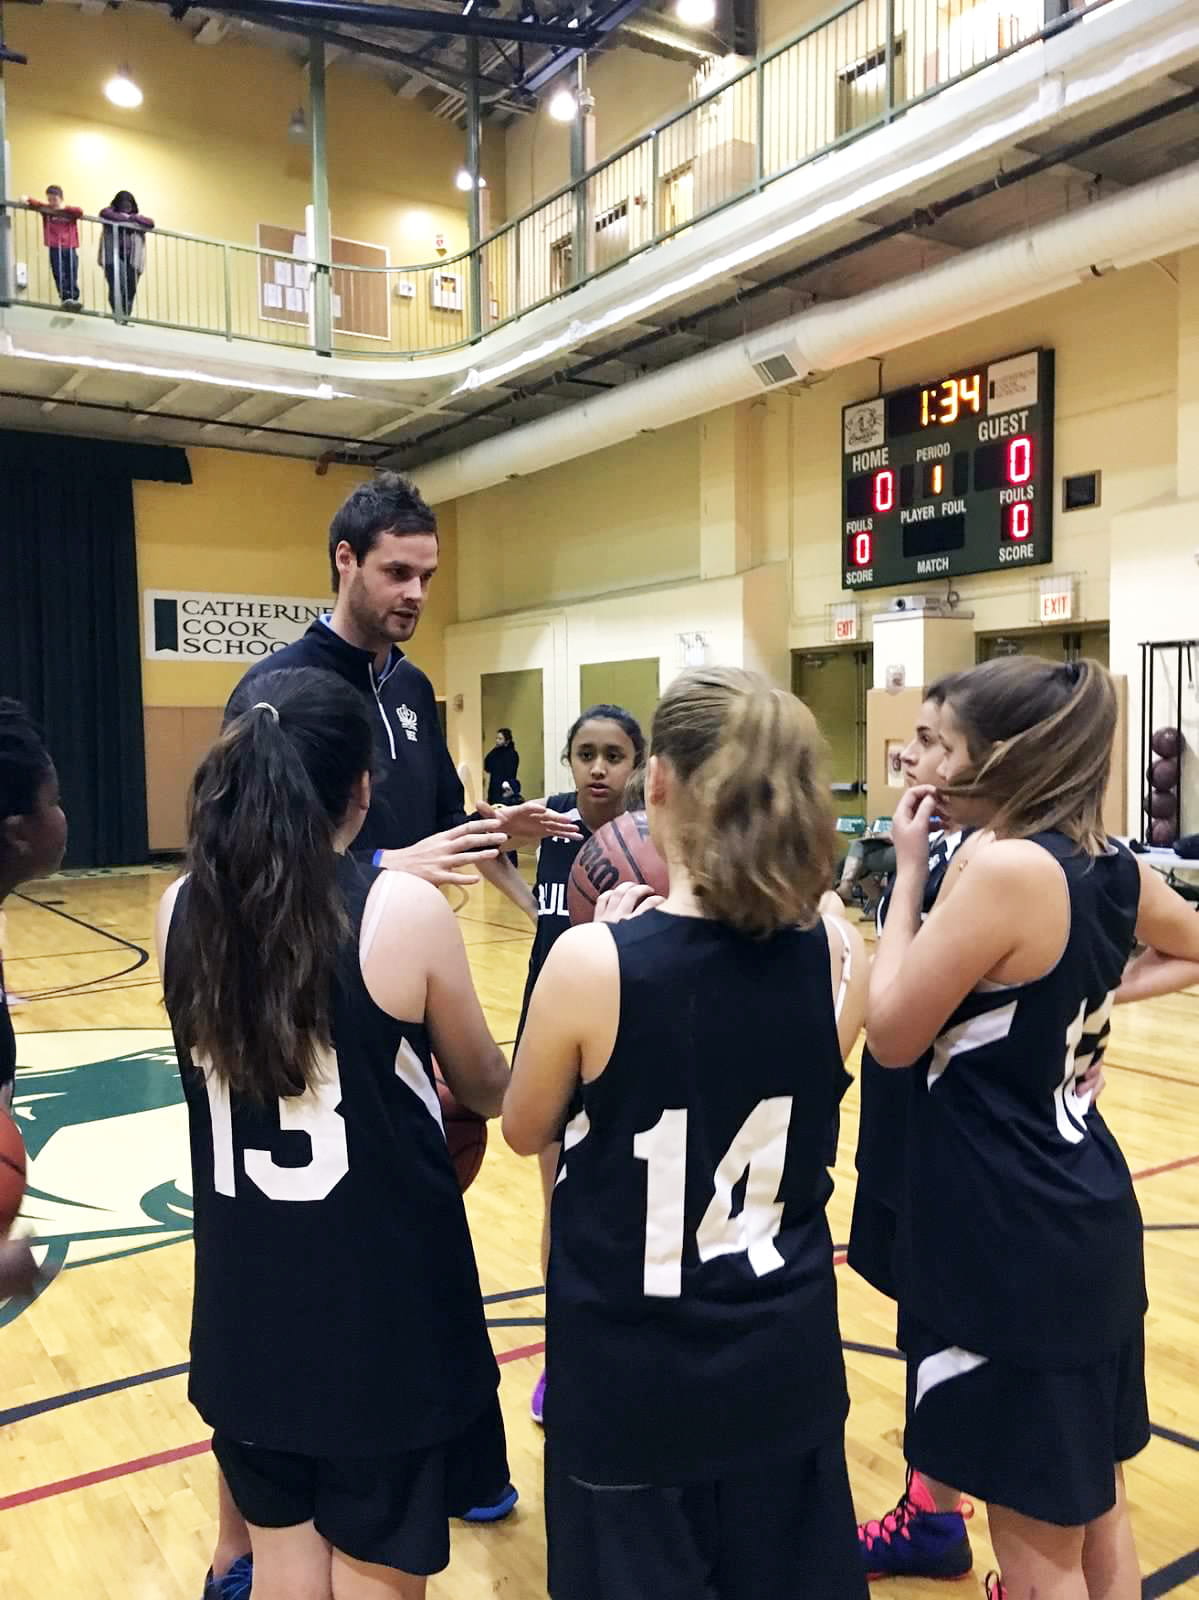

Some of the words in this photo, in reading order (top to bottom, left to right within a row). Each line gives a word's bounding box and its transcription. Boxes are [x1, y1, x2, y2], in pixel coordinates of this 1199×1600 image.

[922, 374, 980, 426] 1:34
[978, 411, 1029, 441] GUEST
[852, 447, 889, 472] HOME
[916, 442, 951, 462] PERIOD
[1010, 438, 1031, 483] 0
[876, 471, 893, 511] 0
[932, 464, 942, 494] 1
[1000, 485, 1034, 504] FOULS
[900, 505, 935, 524] PLAYER
[942, 500, 967, 515] FOUL
[1012, 503, 1029, 537] 0
[846, 518, 873, 534] FOULS
[856, 533, 870, 564] 0
[998, 543, 1034, 562] SCORE
[846, 569, 873, 585] SCORE
[917, 557, 949, 574] MATCH
[1043, 596, 1067, 617] EXIT
[182, 619, 277, 640] COOK
[837, 620, 854, 637] EXIT
[183, 638, 289, 656] SCHOO
[190, 1043, 350, 1202] 13
[633, 1095, 793, 1298] 14
